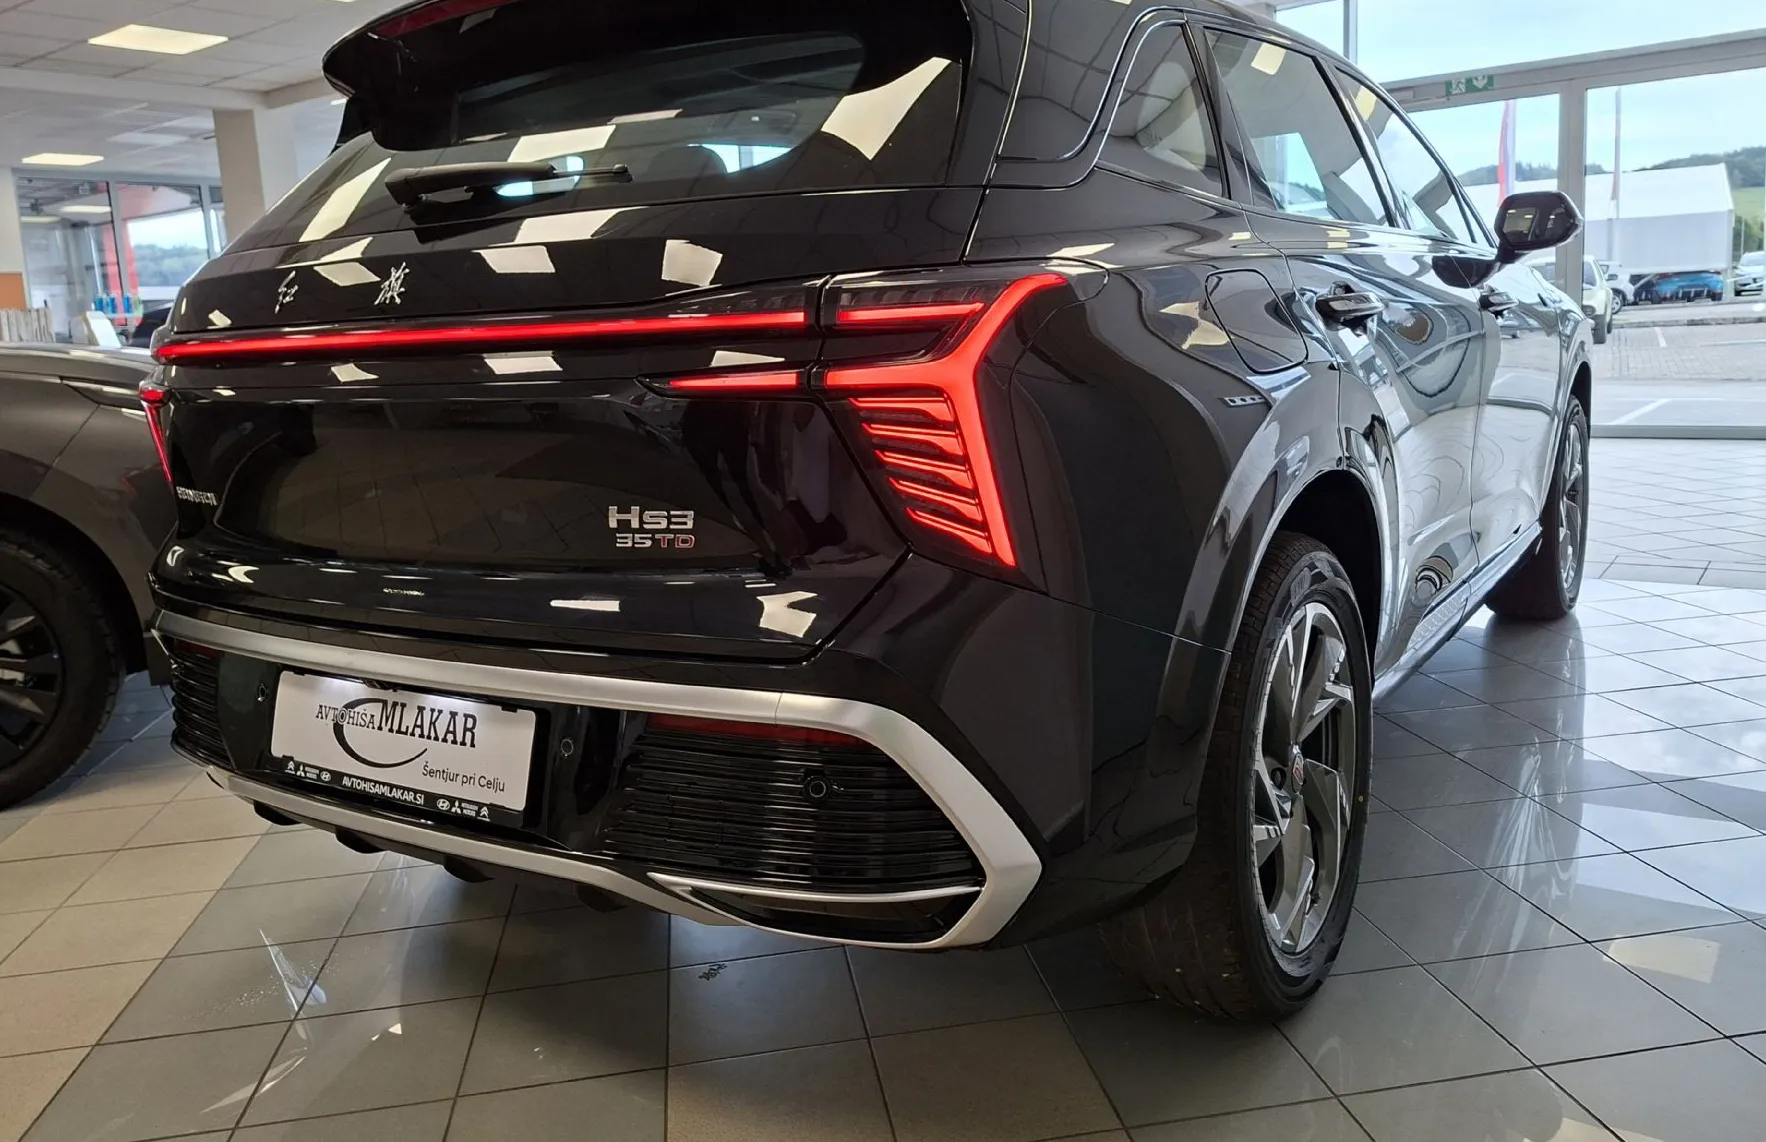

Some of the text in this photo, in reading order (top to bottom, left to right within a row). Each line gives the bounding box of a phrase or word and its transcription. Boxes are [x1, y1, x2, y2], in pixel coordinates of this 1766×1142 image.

[608, 505, 695, 529] HS3
[615, 533, 695, 549] 35TD
[315, 700, 478, 748] AVTOHIŠA MLAKAR
[342, 776, 425, 806] AVTOHISAMLAKAR.SI
[422, 761, 506, 793] Šentjur pri Celju
